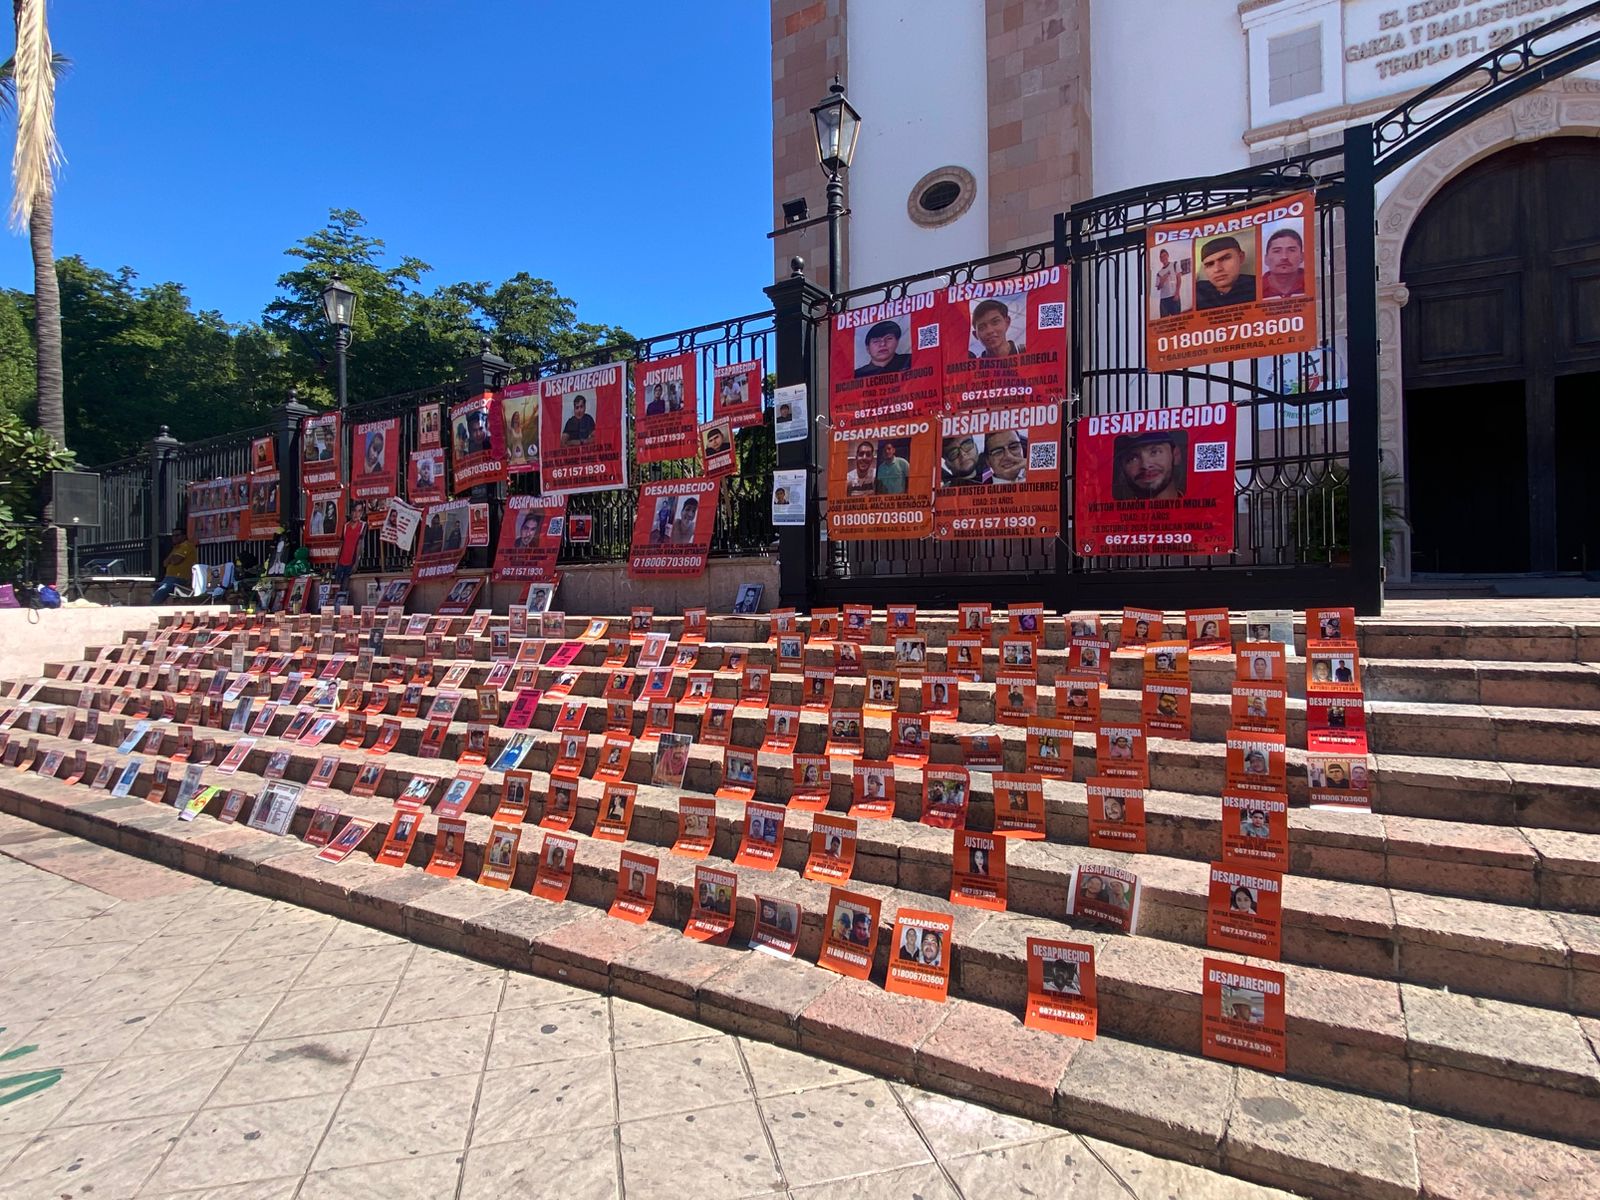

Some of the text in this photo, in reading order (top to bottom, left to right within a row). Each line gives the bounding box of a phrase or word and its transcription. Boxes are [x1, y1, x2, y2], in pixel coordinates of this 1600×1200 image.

[1379, 10, 1403, 31] EL
[1345, 32, 1406, 63] GARZA
[1409, 26, 1423, 45] Y
[1376, 43, 1453, 80] TEMPLO
[1456, 36, 1485, 59] EL
[1154, 201, 1305, 245] DESAPARECIDO
[947, 266, 1060, 304] DESAPARECIDO
[837, 291, 934, 331] DESAPARECIDO
[1157, 316, 1304, 352] 018006703600
[1020, 351, 1058, 366] ARREOLA
[545, 368, 617, 398] DESAPARECIDO
[643, 364, 684, 387] JUSTICIA
[866, 373, 899, 388] LECHUGA
[961, 387, 1033, 402] 6671571930
[854, 401, 914, 419] 6671571930
[941, 404, 1058, 438] DESAPARECIDO
[1089, 405, 1226, 436] DESAPARECIDO
[833, 422, 930, 442] DESAPARECIDO
[552, 464, 606, 479] 667 157 1930
[644, 482, 715, 496] DESAPARECIDO
[1019, 482, 1058, 492] GUTIERREZ
[833, 510, 924, 527] 018006703600
[952, 516, 1037, 530] 667 157 1930
[1105, 533, 1193, 545] 6671571930
[633, 556, 702, 568] 018006703600
[1232, 687, 1282, 698] DESAPARECIDO
[1309, 697, 1362, 708] DESAPARECIDO
[1227, 740, 1285, 753] DESAPARECIDO
[994, 780, 1041, 792] DESAPARECIDO
[1088, 785, 1142, 799] DESAPARECIDO
[1224, 796, 1286, 814] DESAPARECIDO
[963, 836, 995, 851] JUSTICIA
[1081, 864, 1136, 884] DESAPARECIDO
[1212, 870, 1279, 893] DESAPARECIDA
[899, 916, 950, 931] DESAPARECIDO
[1033, 944, 1091, 964] DESAPARECIDO
[1209, 968, 1281, 995] DESAPARECIDO
[1215, 1034, 1272, 1053] 6671571930
